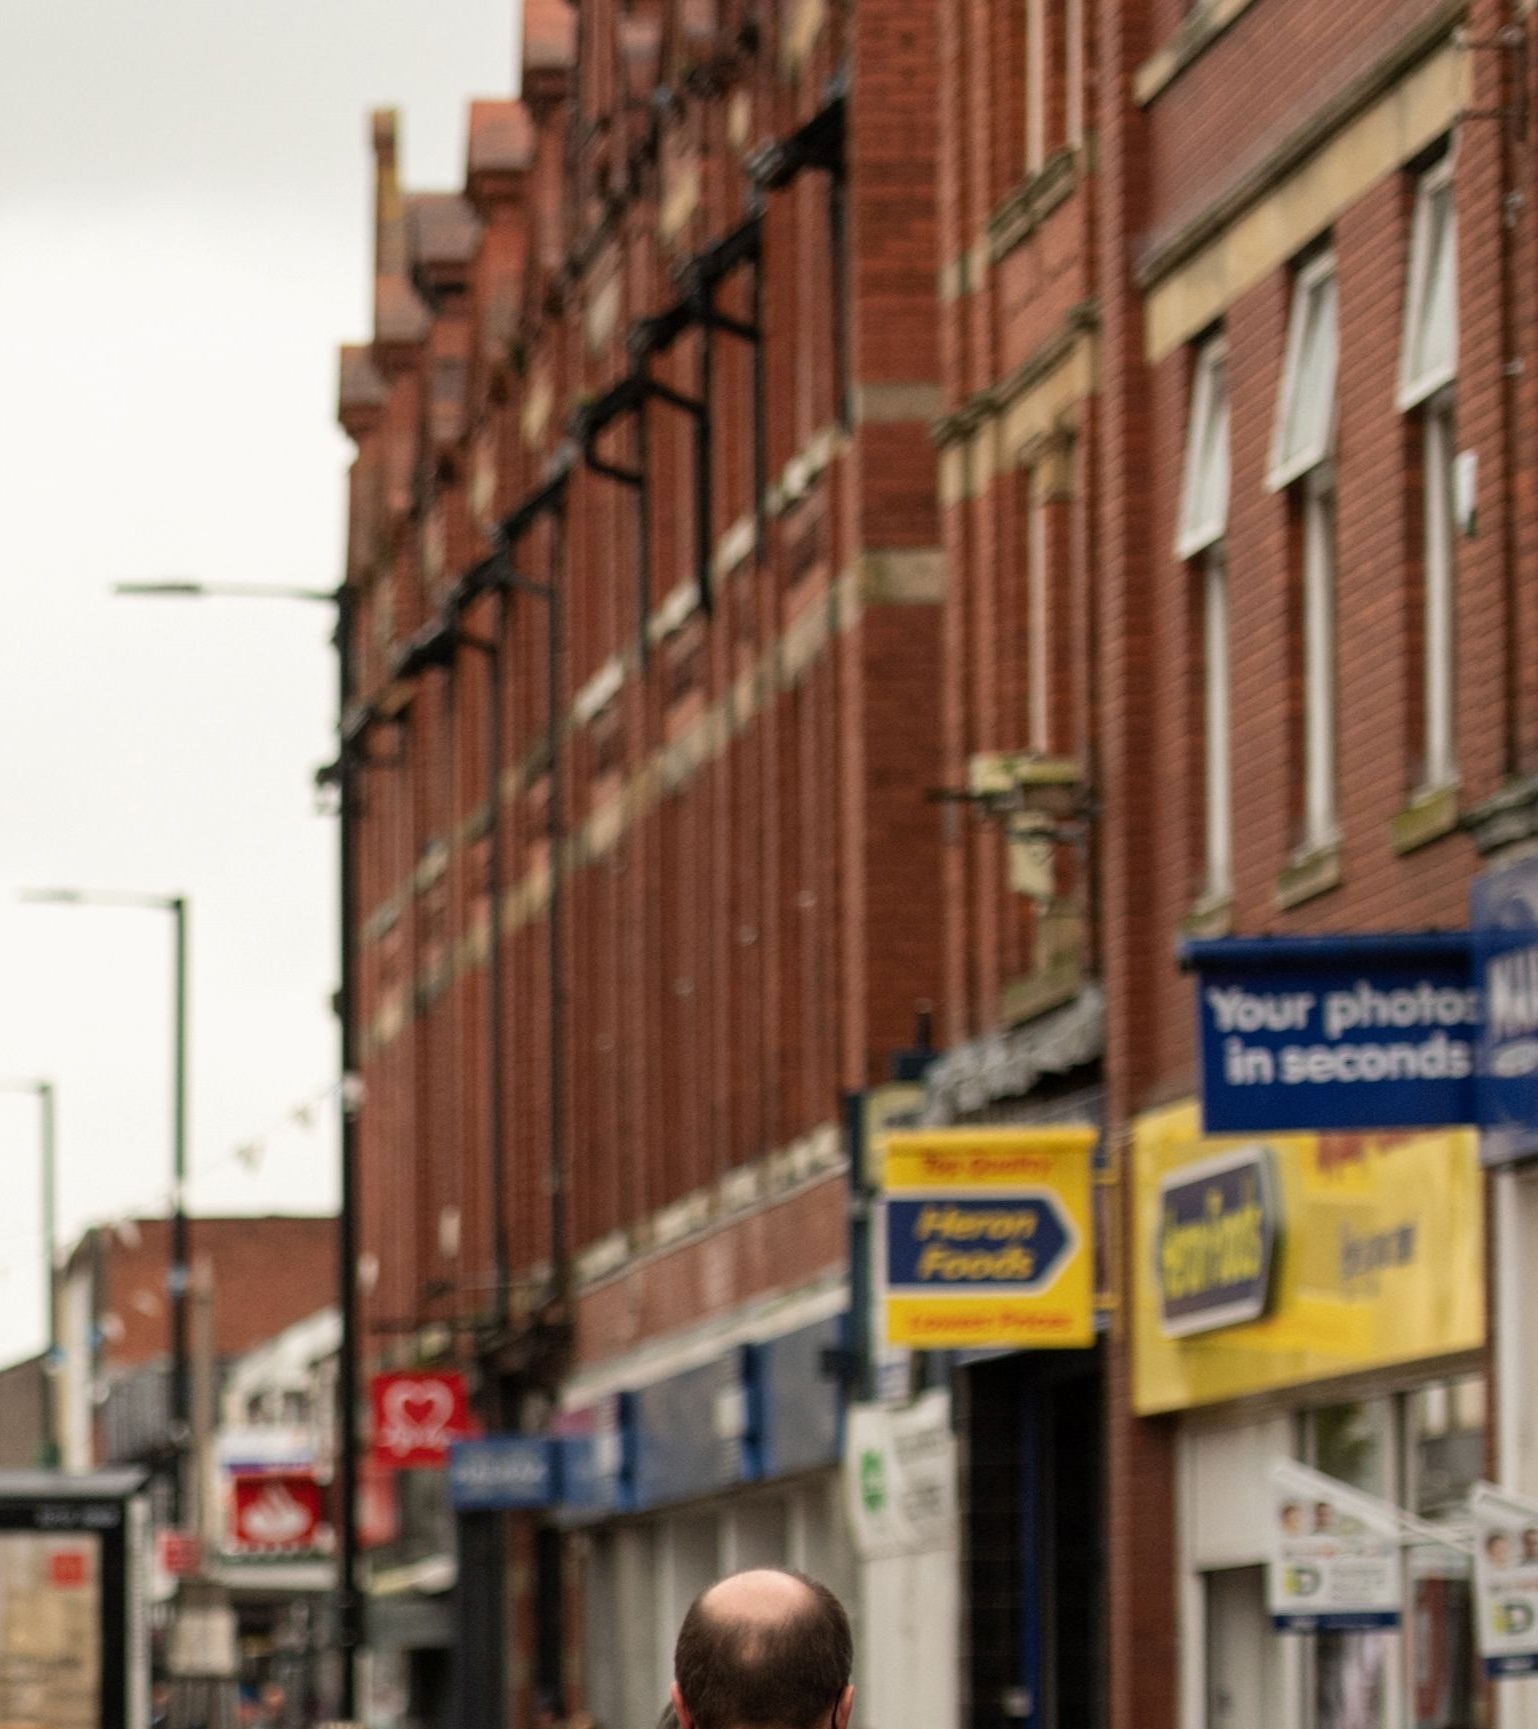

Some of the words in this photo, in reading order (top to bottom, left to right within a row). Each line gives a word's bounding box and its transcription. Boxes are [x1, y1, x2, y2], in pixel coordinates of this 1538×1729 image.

[1207, 985, 1316, 1033] Your
[1225, 1036, 1274, 1086] in
[1279, 1031, 1473, 1084] seconds
[915, 1206, 1038, 1240] Heron
[918, 1244, 1034, 1281] Foods
